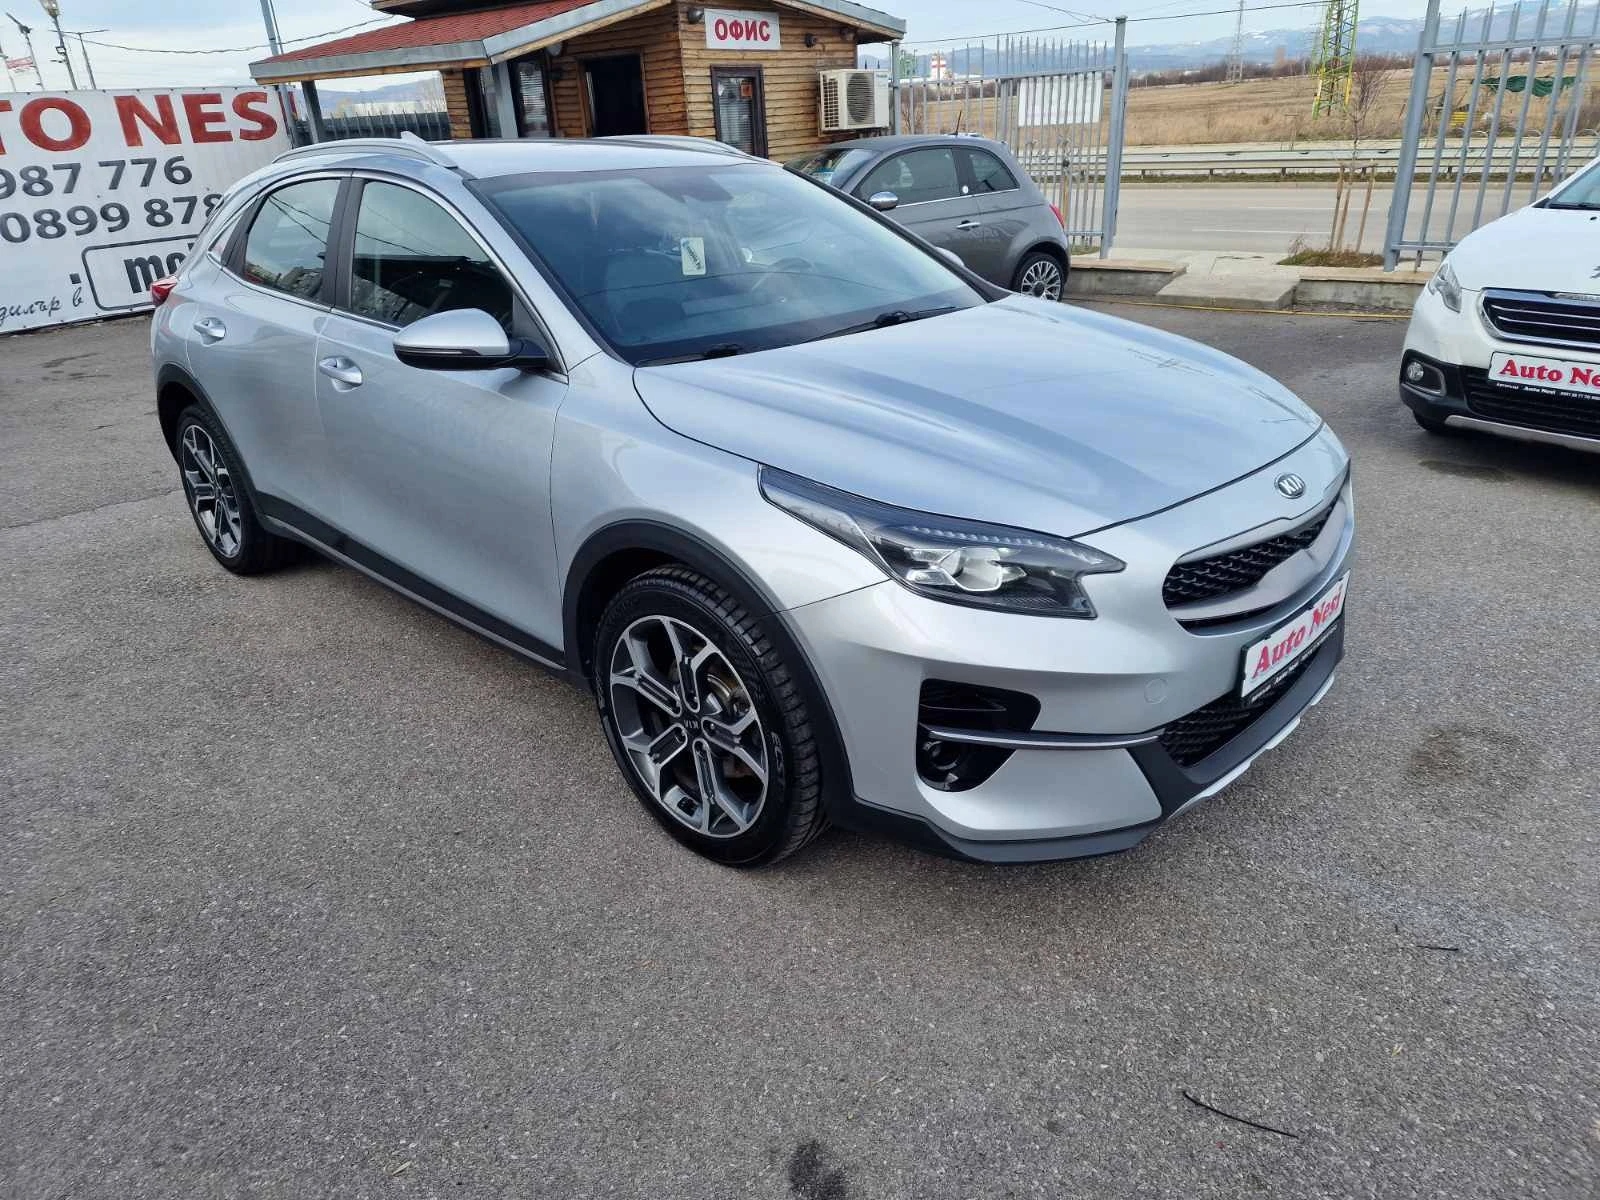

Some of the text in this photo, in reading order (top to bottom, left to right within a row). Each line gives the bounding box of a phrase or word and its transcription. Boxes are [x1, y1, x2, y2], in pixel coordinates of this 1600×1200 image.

[714, 18, 771, 42] ОФИС
[98, 155, 193, 190] 776
[0, 202, 130, 244] 0899
[1499, 359, 1563, 382] Auto
[1252, 625, 1306, 680] Auto
